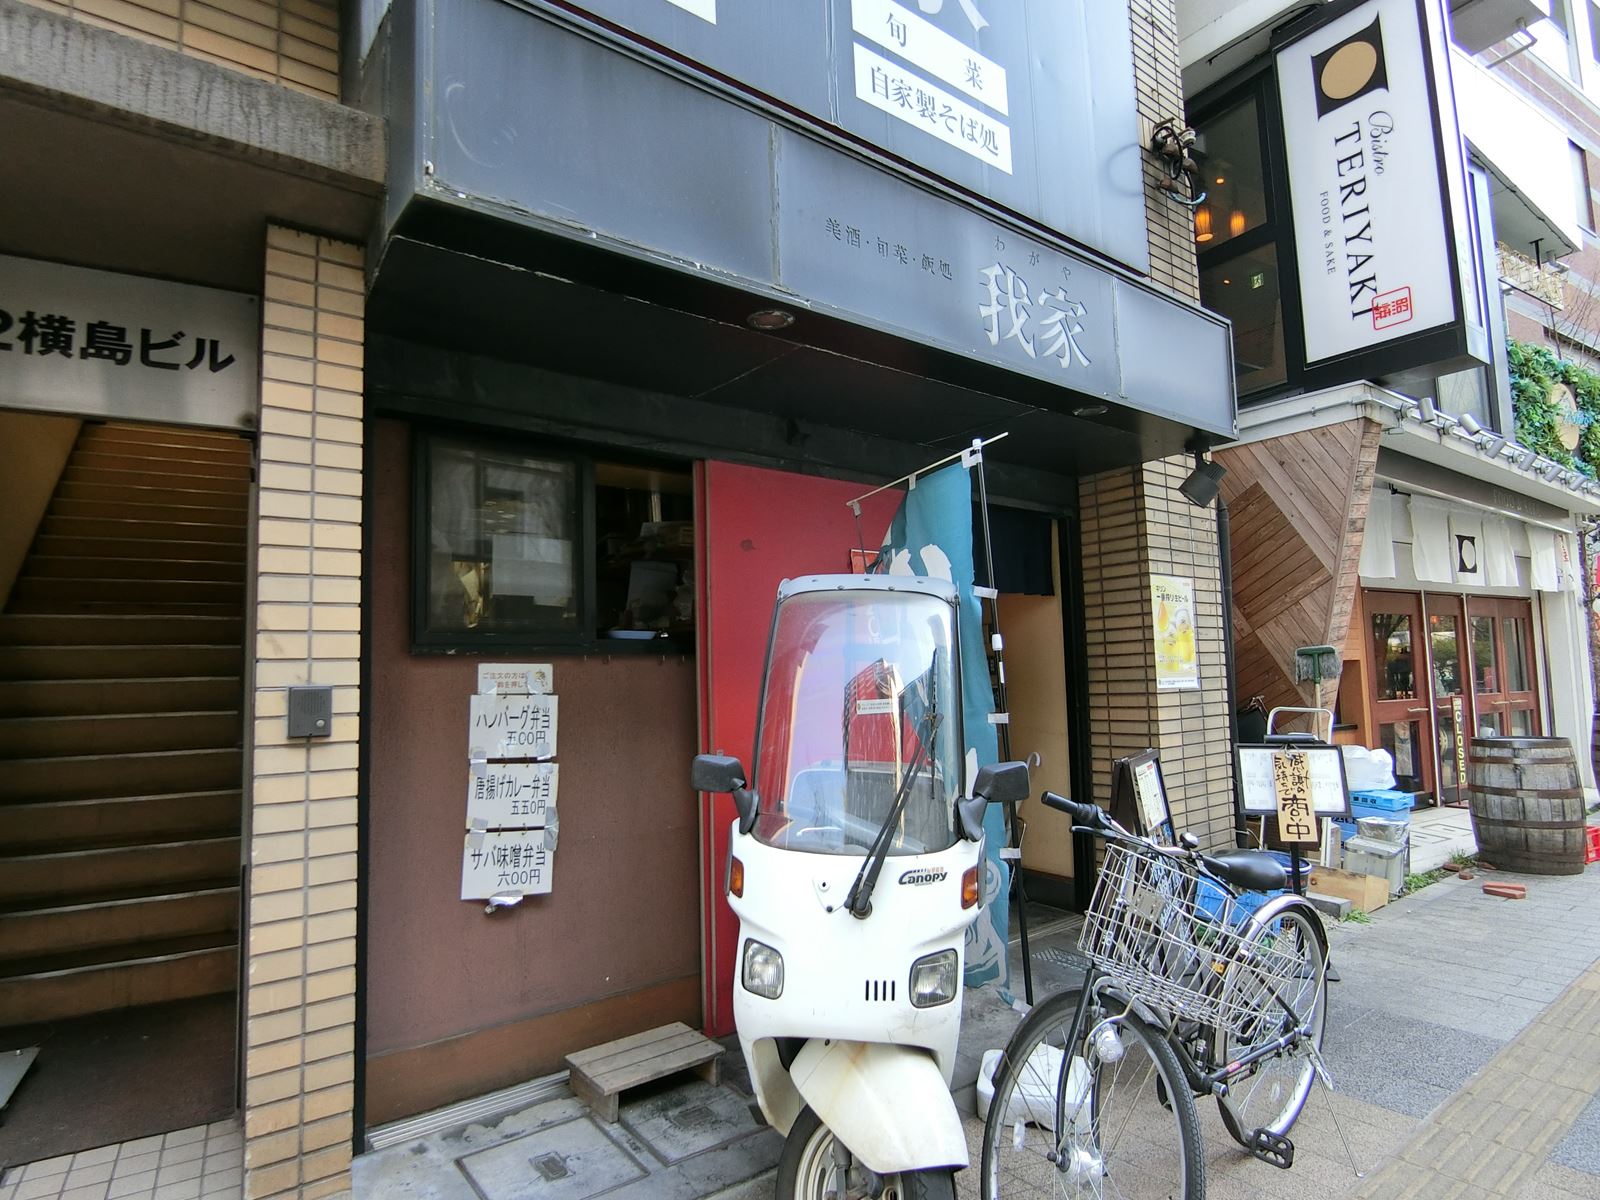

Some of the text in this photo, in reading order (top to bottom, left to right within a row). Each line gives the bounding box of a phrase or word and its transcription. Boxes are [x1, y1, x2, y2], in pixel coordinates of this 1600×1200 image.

[871, 66, 999, 156] 自家製そば処
[1368, 110, 1394, 176] Bistro
[1319, 190, 1336, 276] FOOD & SAKE
[1334, 119, 1380, 321] TERIYAKI
[994, 235, 1071, 281] わがや
[979, 261, 1092, 369] 我家
[476, 704, 550, 730] ハンバーグ弁当
[1455, 711, 1466, 783] CLOSED
[475, 774, 550, 800] 唐揚げカレー弁当
[471, 843, 546, 871] サバ味噌弁当
[898, 868, 948, 885] Canopy
